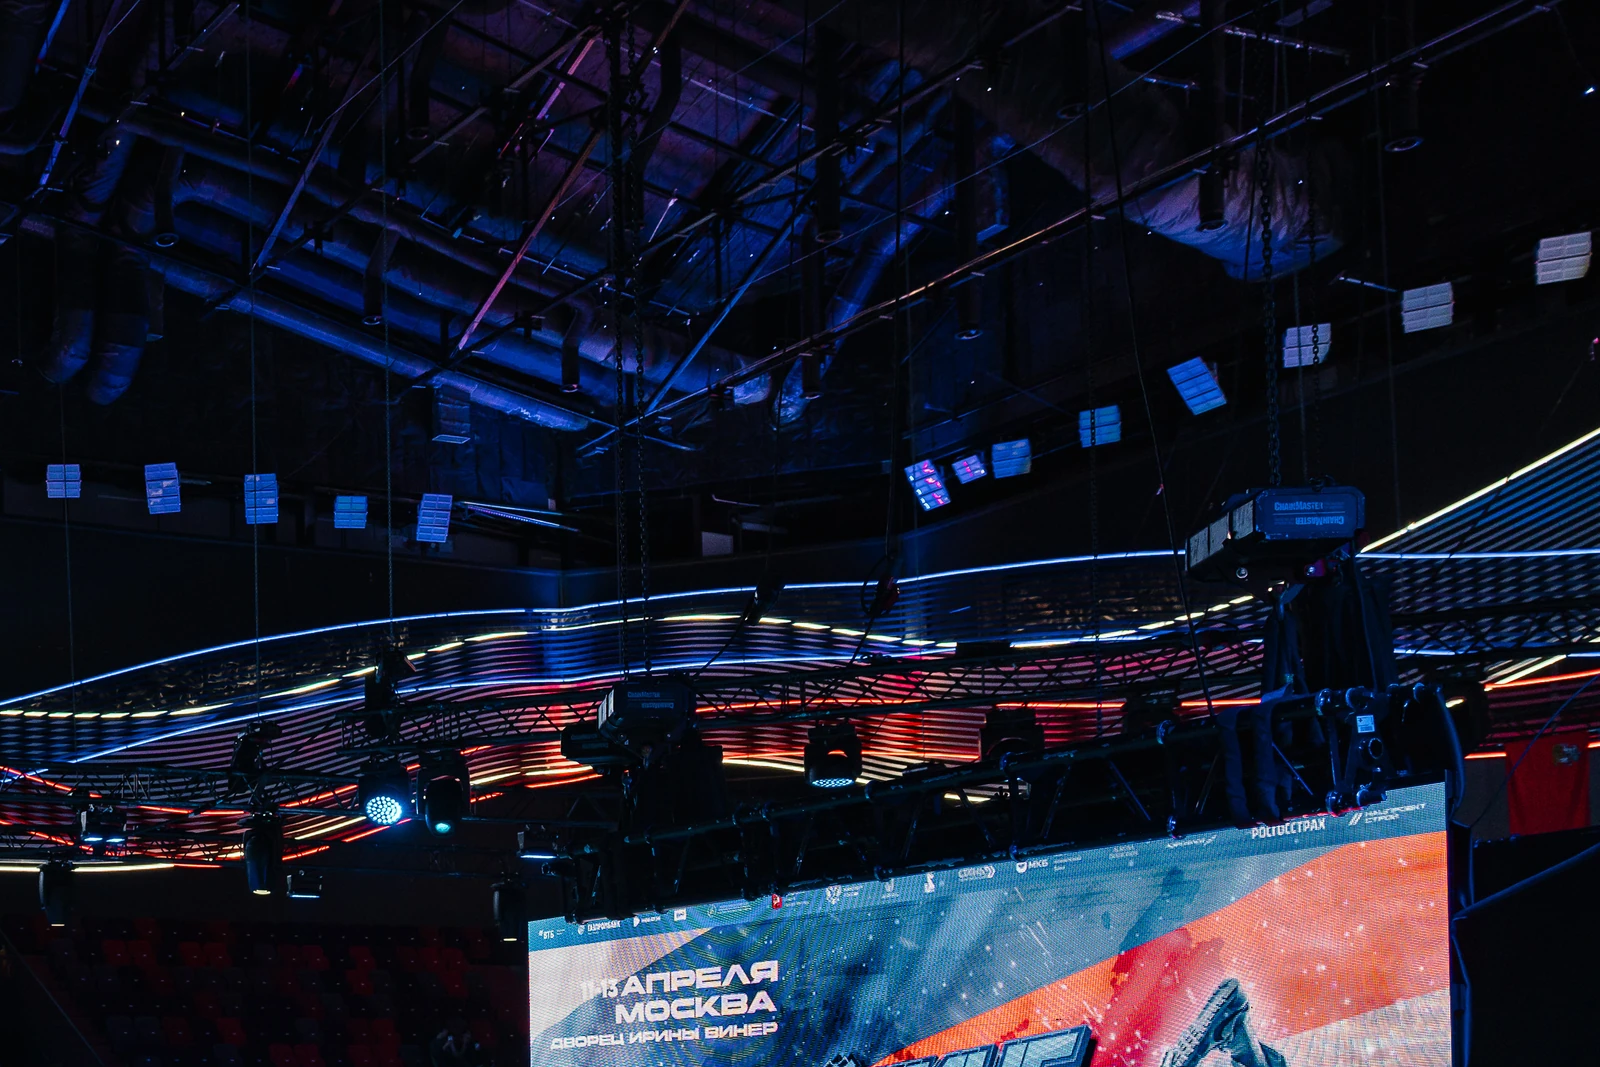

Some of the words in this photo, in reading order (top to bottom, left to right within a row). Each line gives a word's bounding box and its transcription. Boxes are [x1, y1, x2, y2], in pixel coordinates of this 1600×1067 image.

[1251, 817, 1326, 840] РОСГОССТРАХ
[620, 960, 779, 997] АПРЕЛЯ
[615, 990, 777, 1025] МОСКВА
[550, 1033, 625, 1050] ДВОРЕЦ
[629, 1026, 700, 1045] ИРИНЫ
[704, 1021, 779, 1040] ВИНЕР
